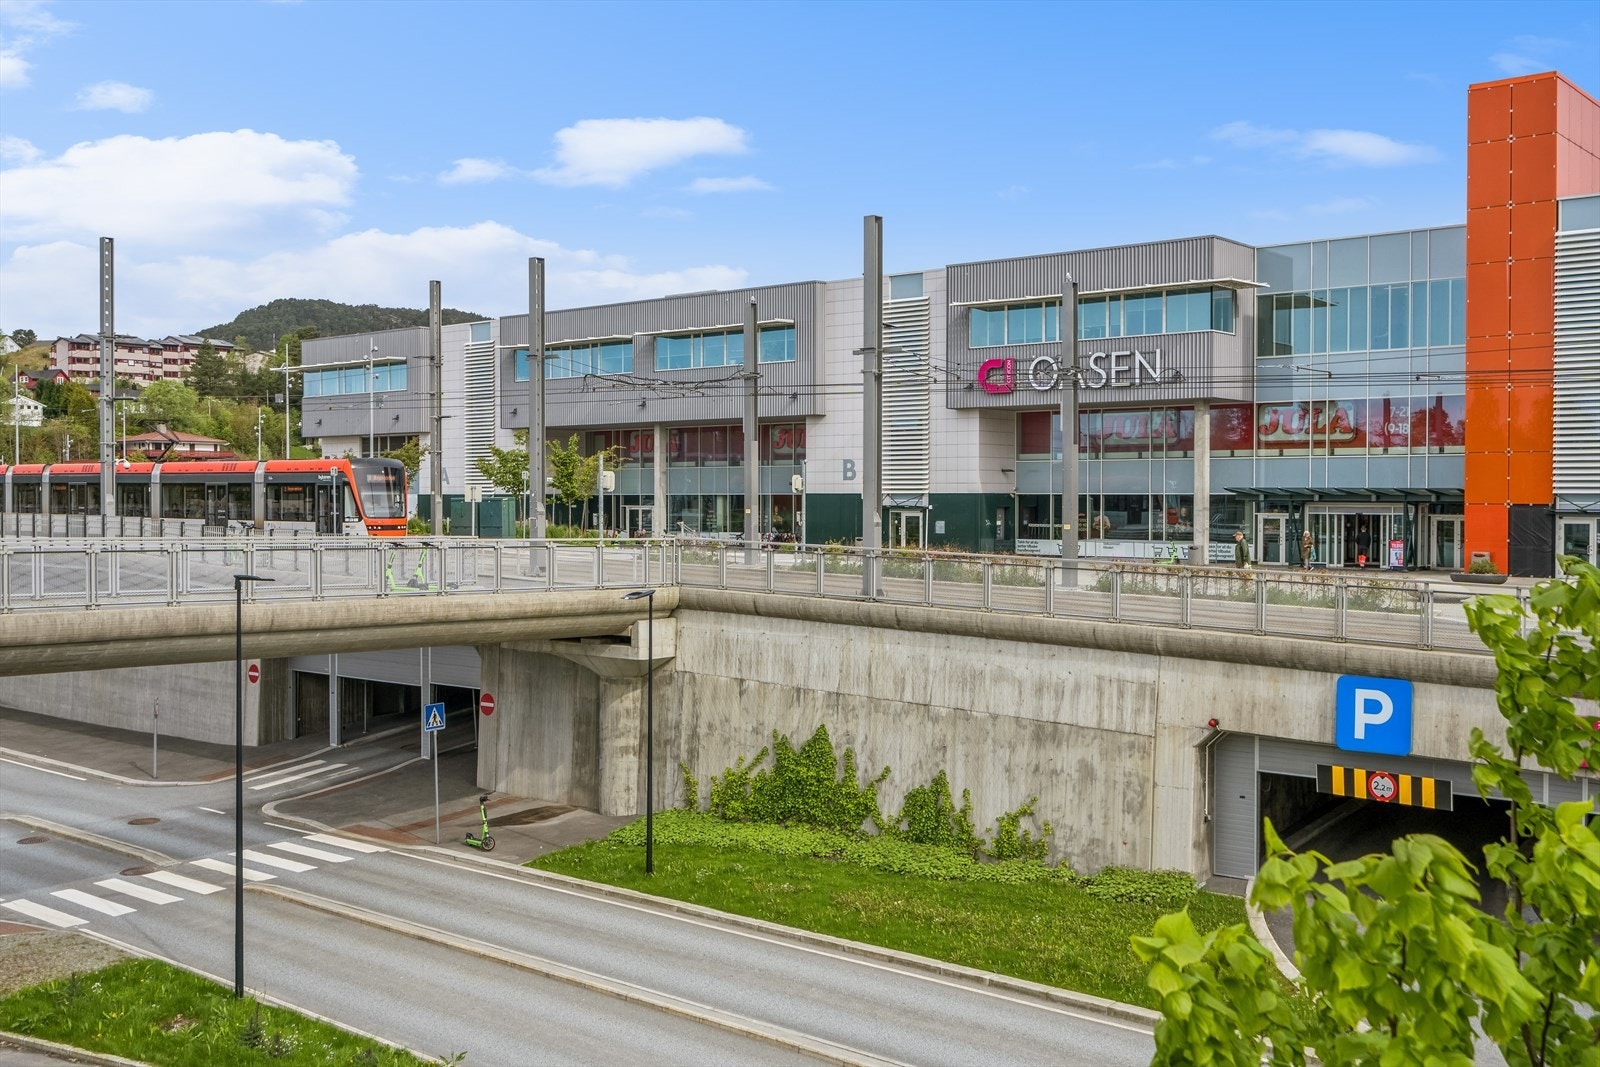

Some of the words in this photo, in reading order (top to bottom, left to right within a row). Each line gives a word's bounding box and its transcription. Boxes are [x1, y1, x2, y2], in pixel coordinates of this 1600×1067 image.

[1096, 415, 1177, 440] JULA
[1258, 407, 1354, 435] JULA
[629, 433, 678, 453] JUA
[842, 458, 857, 481] B
[1354, 688, 1394, 739] P
